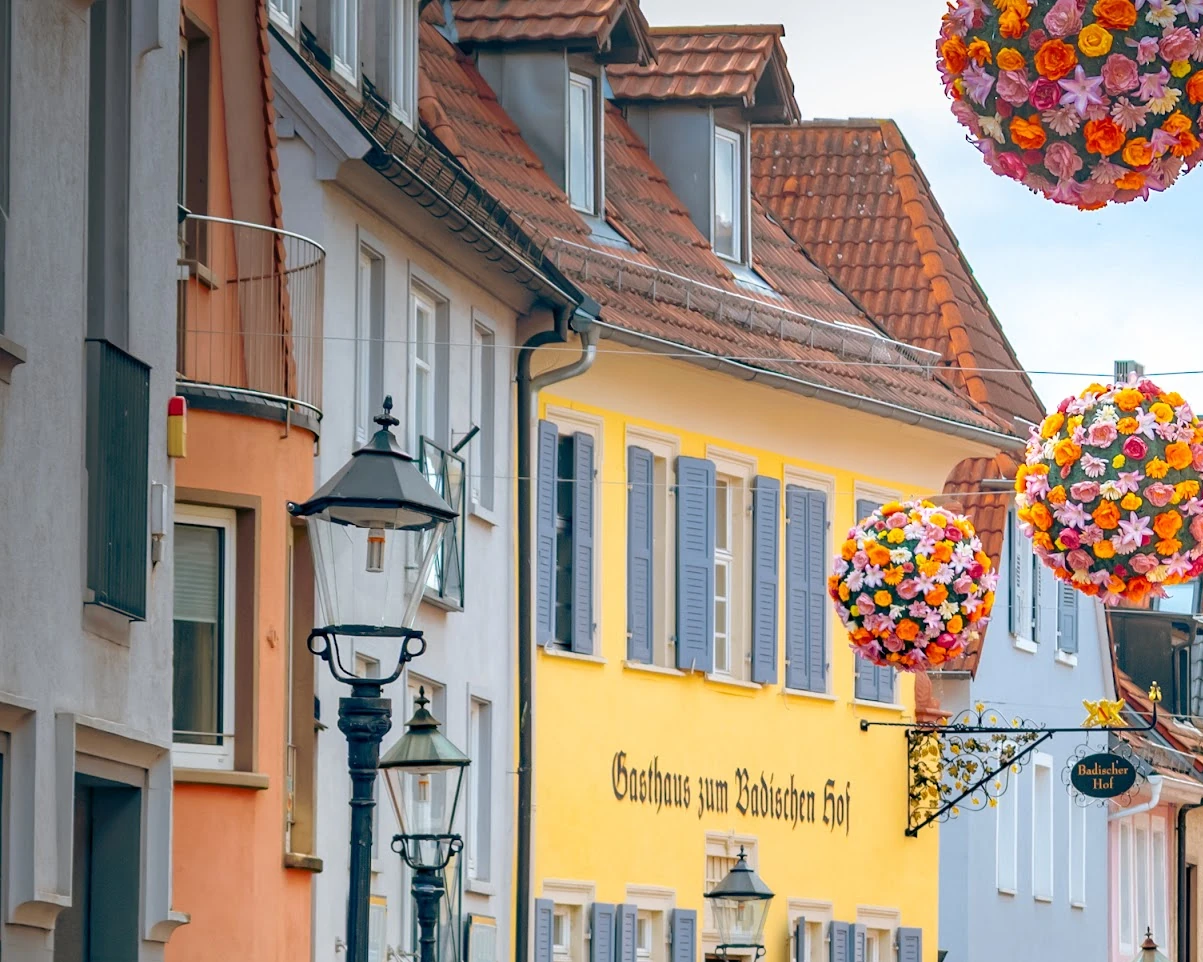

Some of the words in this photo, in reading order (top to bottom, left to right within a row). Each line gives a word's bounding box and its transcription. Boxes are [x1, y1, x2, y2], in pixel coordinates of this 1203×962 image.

[1078, 762, 1129, 776] Badischer
[1093, 776, 1114, 790] Hof
[611, 750, 691, 814] Gasthaus
[697, 775, 729, 820] zum
[735, 767, 815, 830] Badischen
[822, 778, 851, 837] Hof
